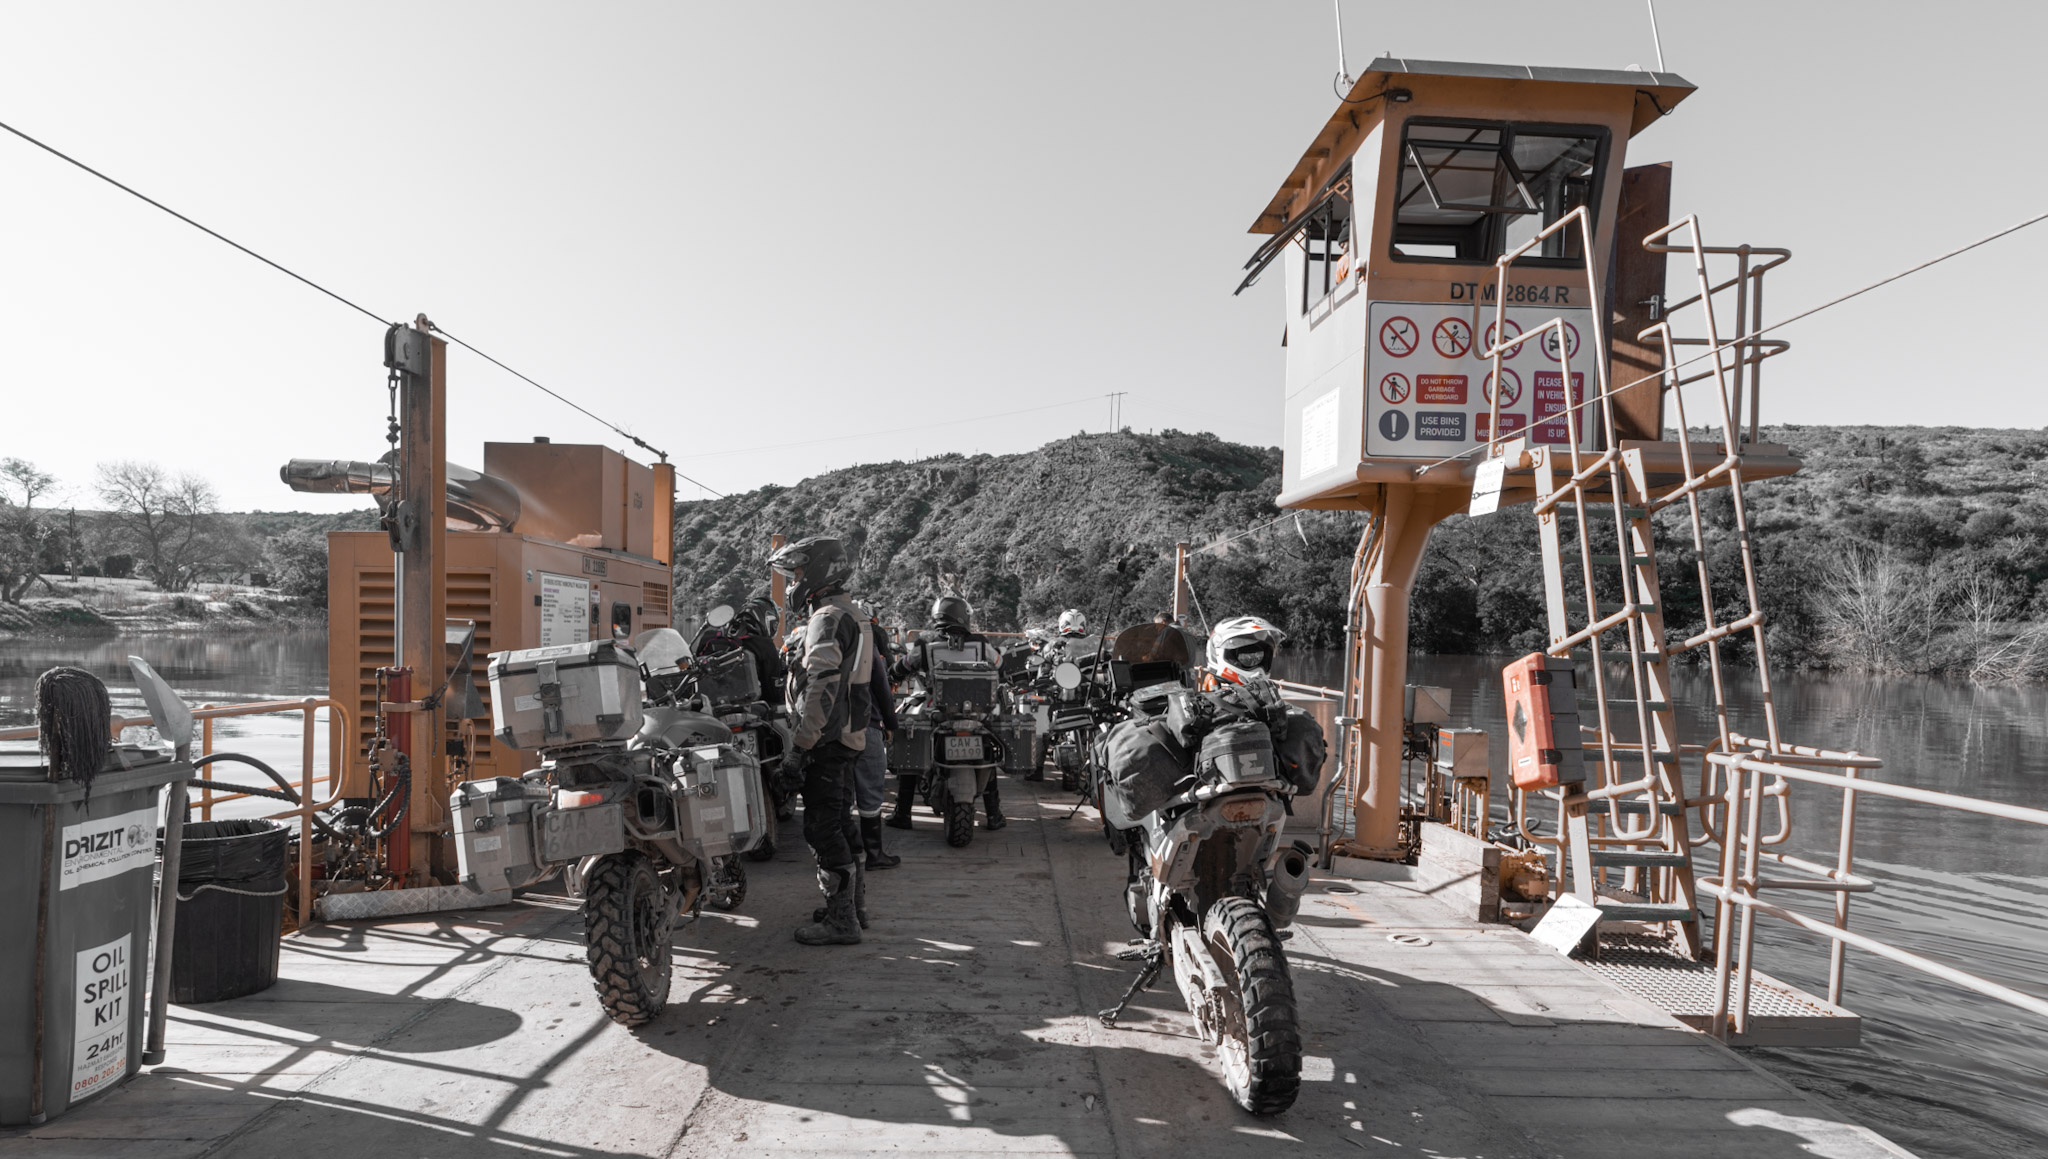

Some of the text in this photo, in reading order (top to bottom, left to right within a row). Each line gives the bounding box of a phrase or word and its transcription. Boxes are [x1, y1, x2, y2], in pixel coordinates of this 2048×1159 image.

[1450, 282, 1570, 304] DTM 2864 R
[1537, 377, 1562, 387] PLEASE
[1424, 393, 1459, 401] OVERBOARD
[1537, 390, 1579, 400] IN VEHICS.
[1545, 403, 1568, 413] ENSUR
[1421, 416, 1460, 426] USE BINS
[1420, 427, 1461, 437] PROVIDED
[1548, 428, 1555, 438] IS
[950, 737, 982, 748] CAW 1
[548, 807, 616, 833] CAA 1
[65, 827, 125, 859] DRIZIT
[64, 868, 74, 876] OIL
[92, 946, 125, 974] OIL
[83, 968, 128, 1004] SPILL
[94, 996, 122, 1027] KIT
[86, 1031, 124, 1060] 24hr
[74, 1073, 99, 1091] 0800
[101, 1065, 115, 1080] 202
